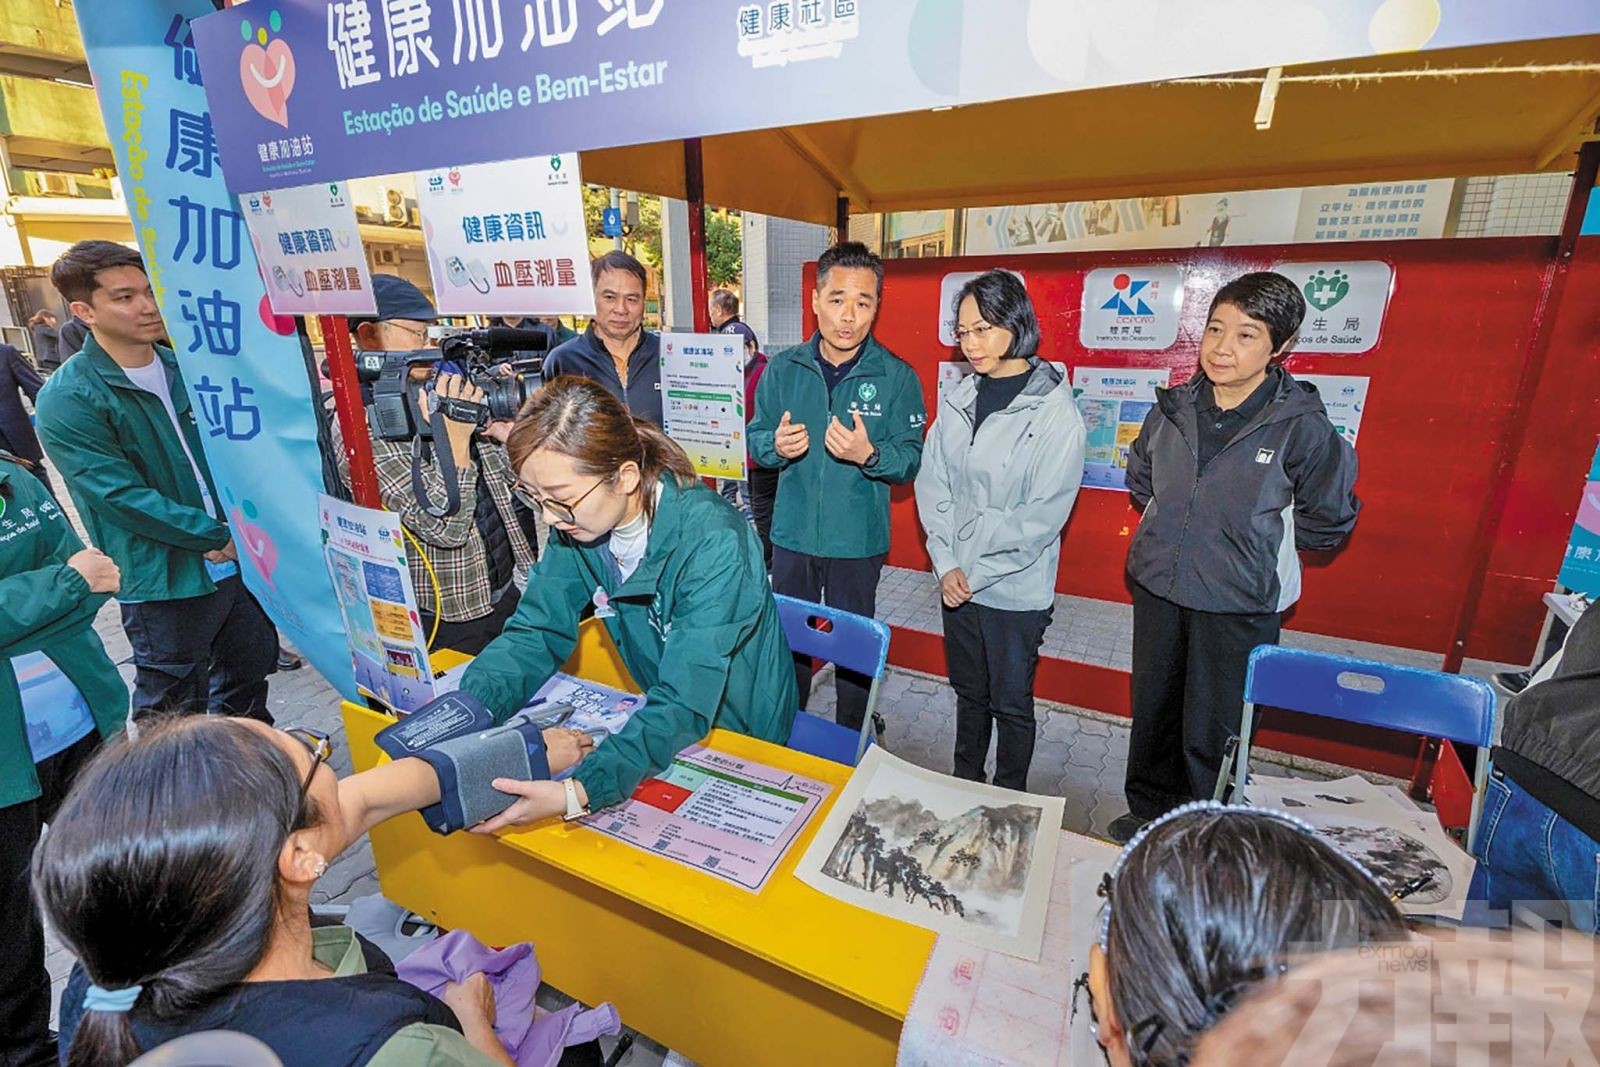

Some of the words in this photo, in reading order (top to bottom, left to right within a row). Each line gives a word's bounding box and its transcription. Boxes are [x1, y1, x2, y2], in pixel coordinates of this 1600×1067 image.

[739, 0, 857, 36] 健康社區
[343, 102, 415, 136] Estação
[418, 98, 443, 123] de
[446, 84, 513, 119] Saúde
[517, 88, 532, 106] e
[535, 59, 669, 104] Bem-Estar
[278, 229, 337, 255] 健康資訊
[462, 210, 547, 244] 健康資訊
[304, 267, 362, 292] 血壓測量
[494, 258, 577, 288] 血壓測量
[1315, 335, 1328, 344] de
[1330, 334, 1362, 344] Saúde
